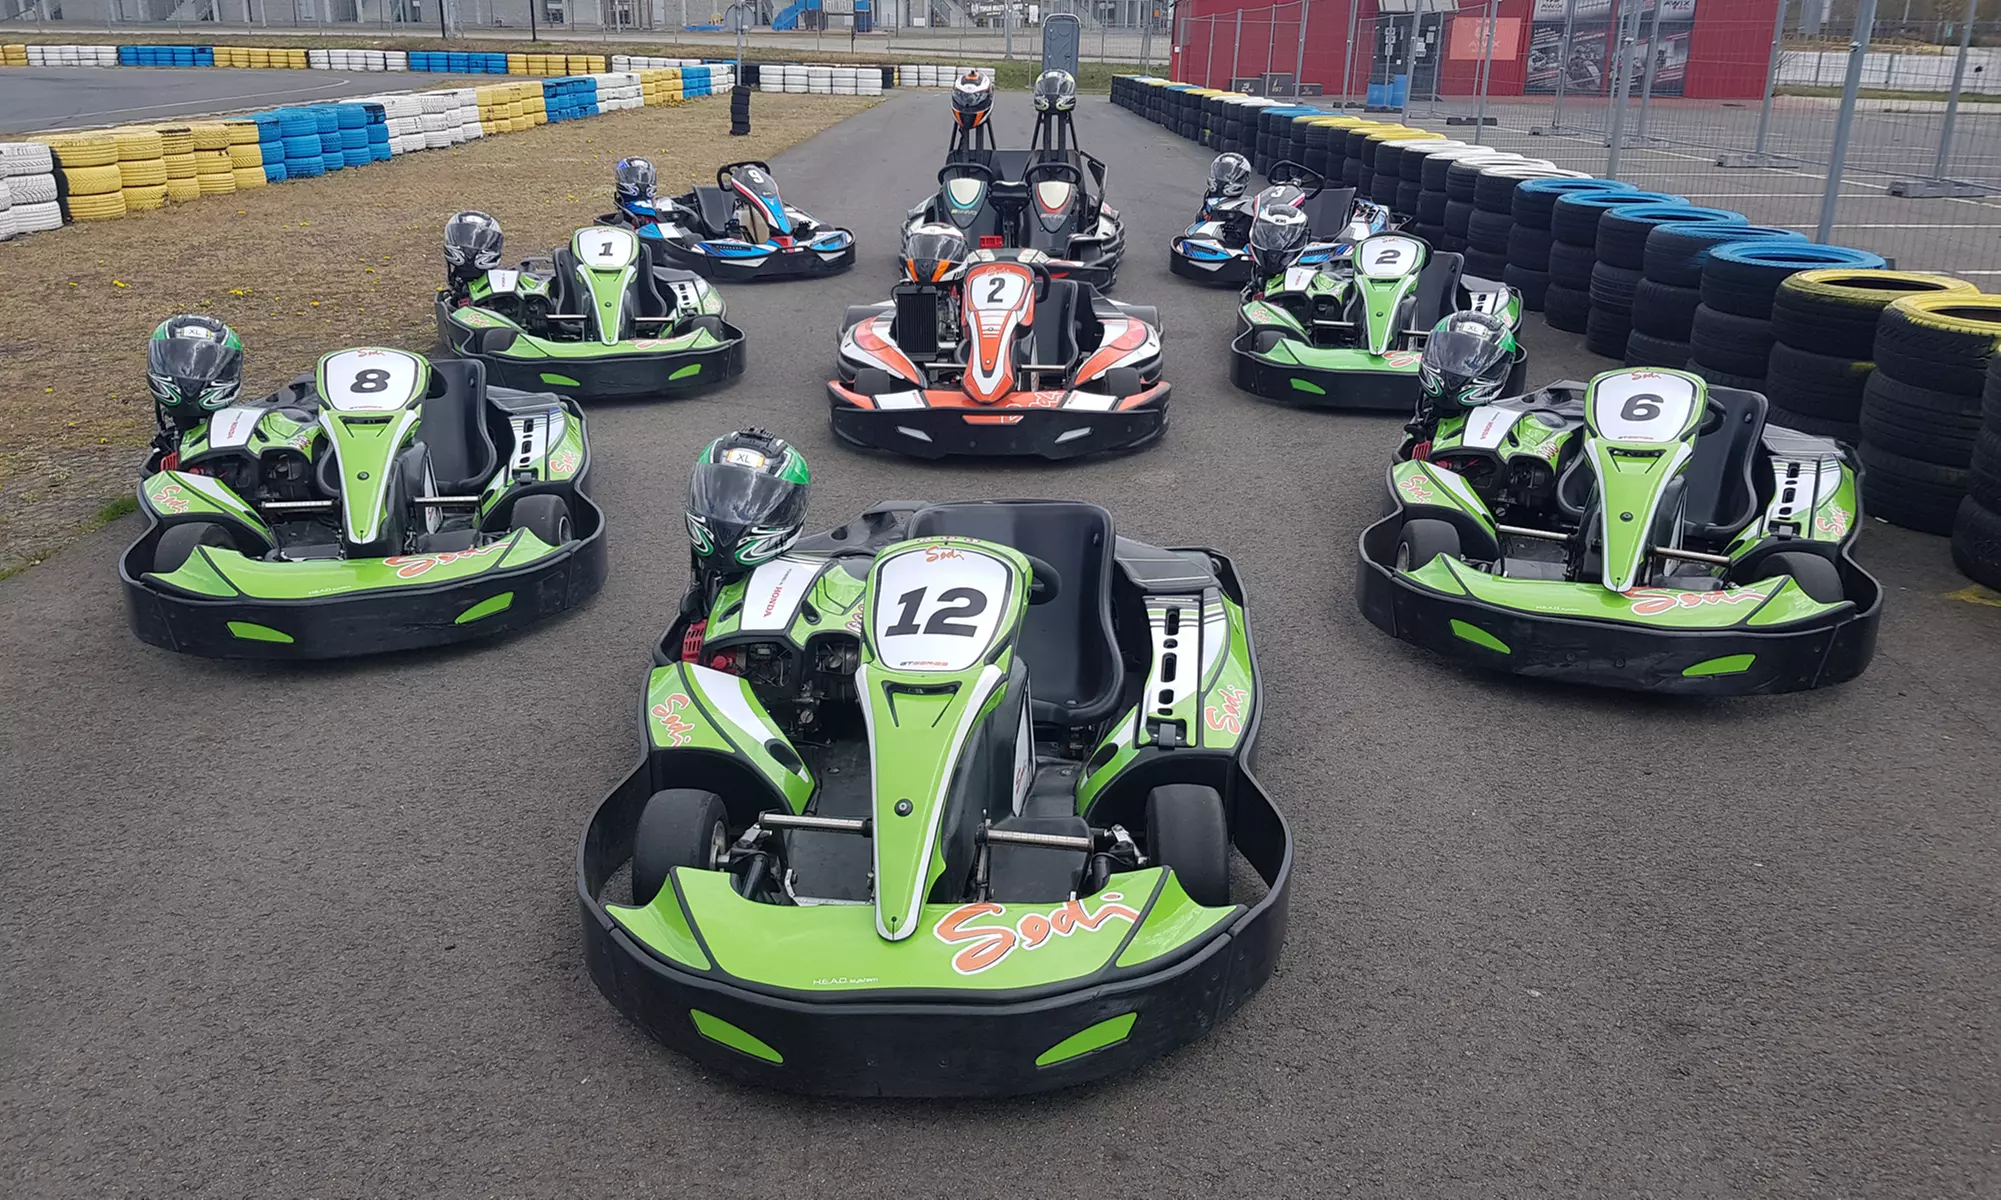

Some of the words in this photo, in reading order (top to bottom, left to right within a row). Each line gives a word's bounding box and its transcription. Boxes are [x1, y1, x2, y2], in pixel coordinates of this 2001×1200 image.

[748, 170, 764, 183] 9
[1271, 186, 1286, 197] 3
[599, 242, 613, 256] 1
[1375, 249, 1401, 265] 2
[987, 278, 1005, 303] 2
[350, 369, 391, 393] 8
[1631, 369, 1662, 380] Sodi
[1620, 393, 1664, 421] 6
[737, 453, 750, 463] XL
[925, 545, 965, 562] Sodi
[763, 586, 783, 618] HONDA
[884, 586, 988, 638] 12
[651, 693, 695, 748] Sodi
[1204, 684, 1248, 734] Sodi
[933, 892, 1139, 975] Sodi
